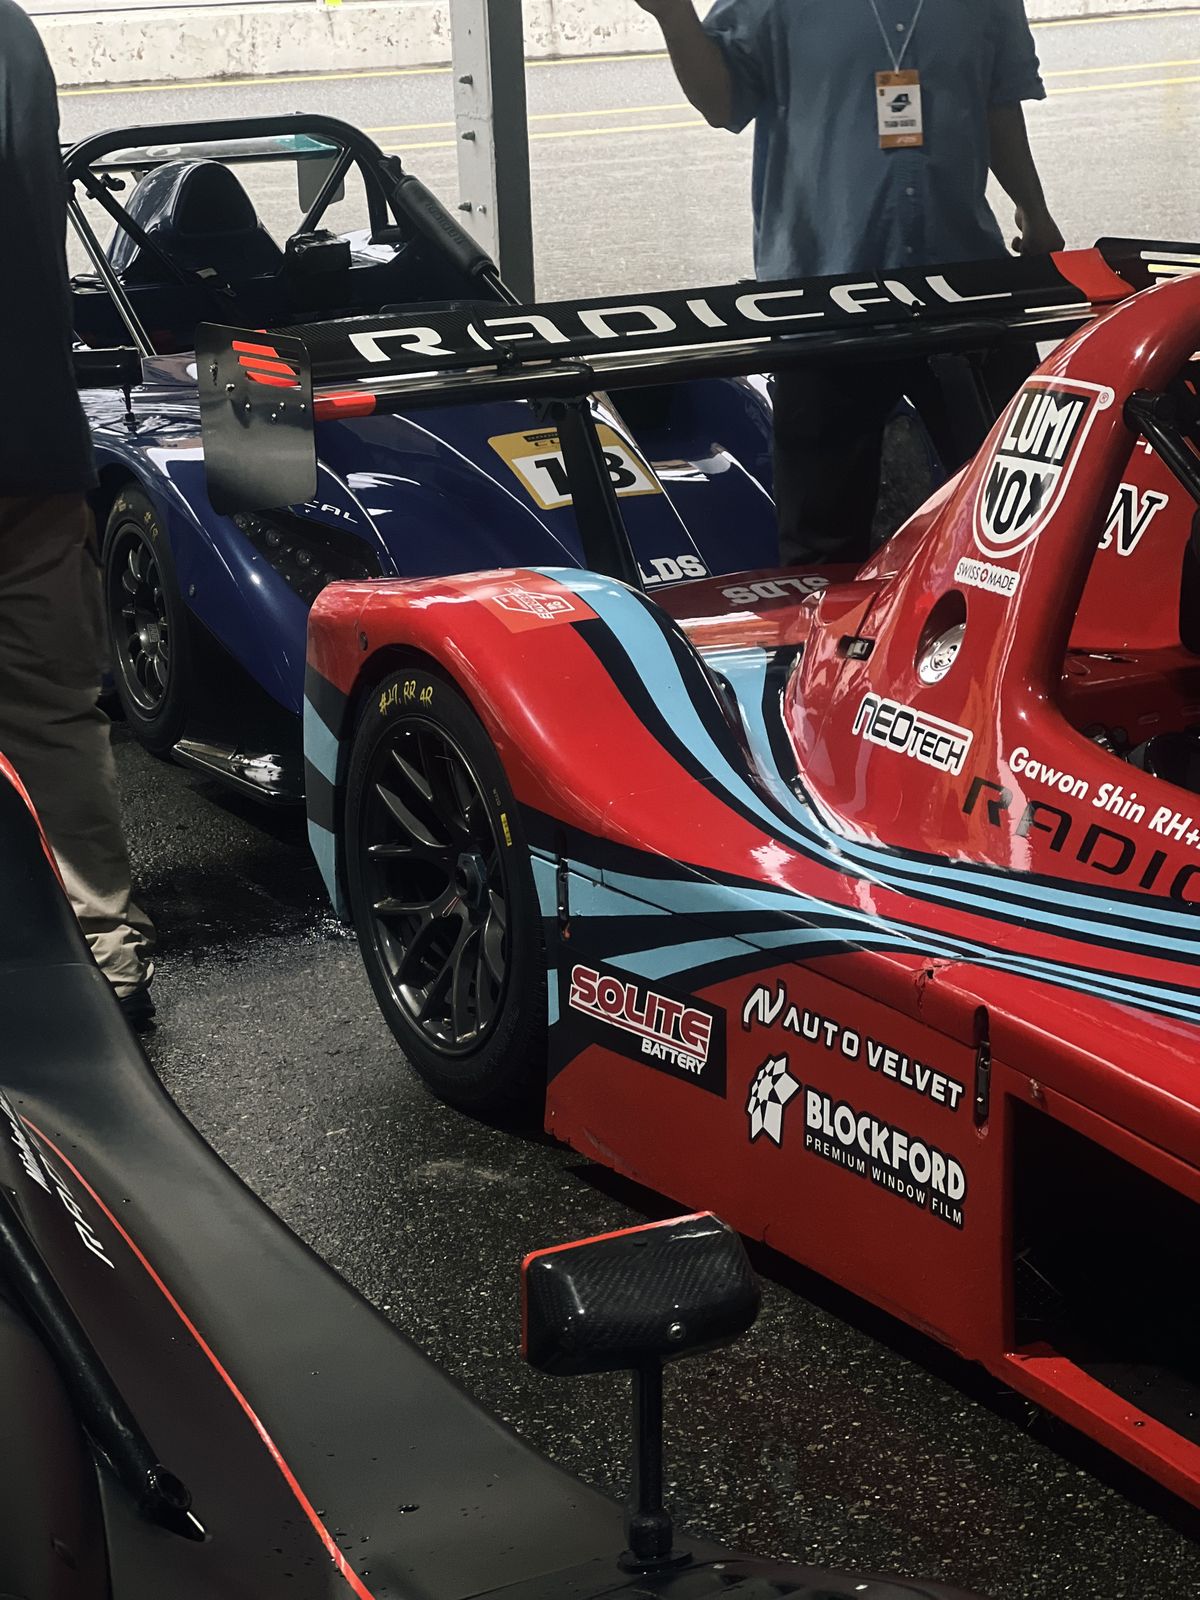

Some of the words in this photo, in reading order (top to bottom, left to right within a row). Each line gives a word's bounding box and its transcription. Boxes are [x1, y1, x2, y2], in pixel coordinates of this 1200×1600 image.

[348, 275, 1013, 363] RADICAL
[1001, 393, 1084, 460] LUMI
[985, 461, 1055, 535] NOX
[957, 562, 981, 579] SWISS
[987, 571, 1016, 591] MADE
[1009, 746, 1089, 800] Gawon
[1092, 783, 1146, 824] Shin
[1148, 806, 1200, 850] RH+
[569, 964, 713, 1057] SOLITE
[641, 1037, 706, 1075] BATTERY
[783, 1006, 859, 1058] AUTO
[867, 1040, 963, 1108] VELVET
[806, 1134, 865, 1174] PREMIUM
[872, 1165, 925, 1205] WINDOW
[932, 1197, 962, 1225] FILM
[807, 1089, 966, 1201] BLOCKFORD
